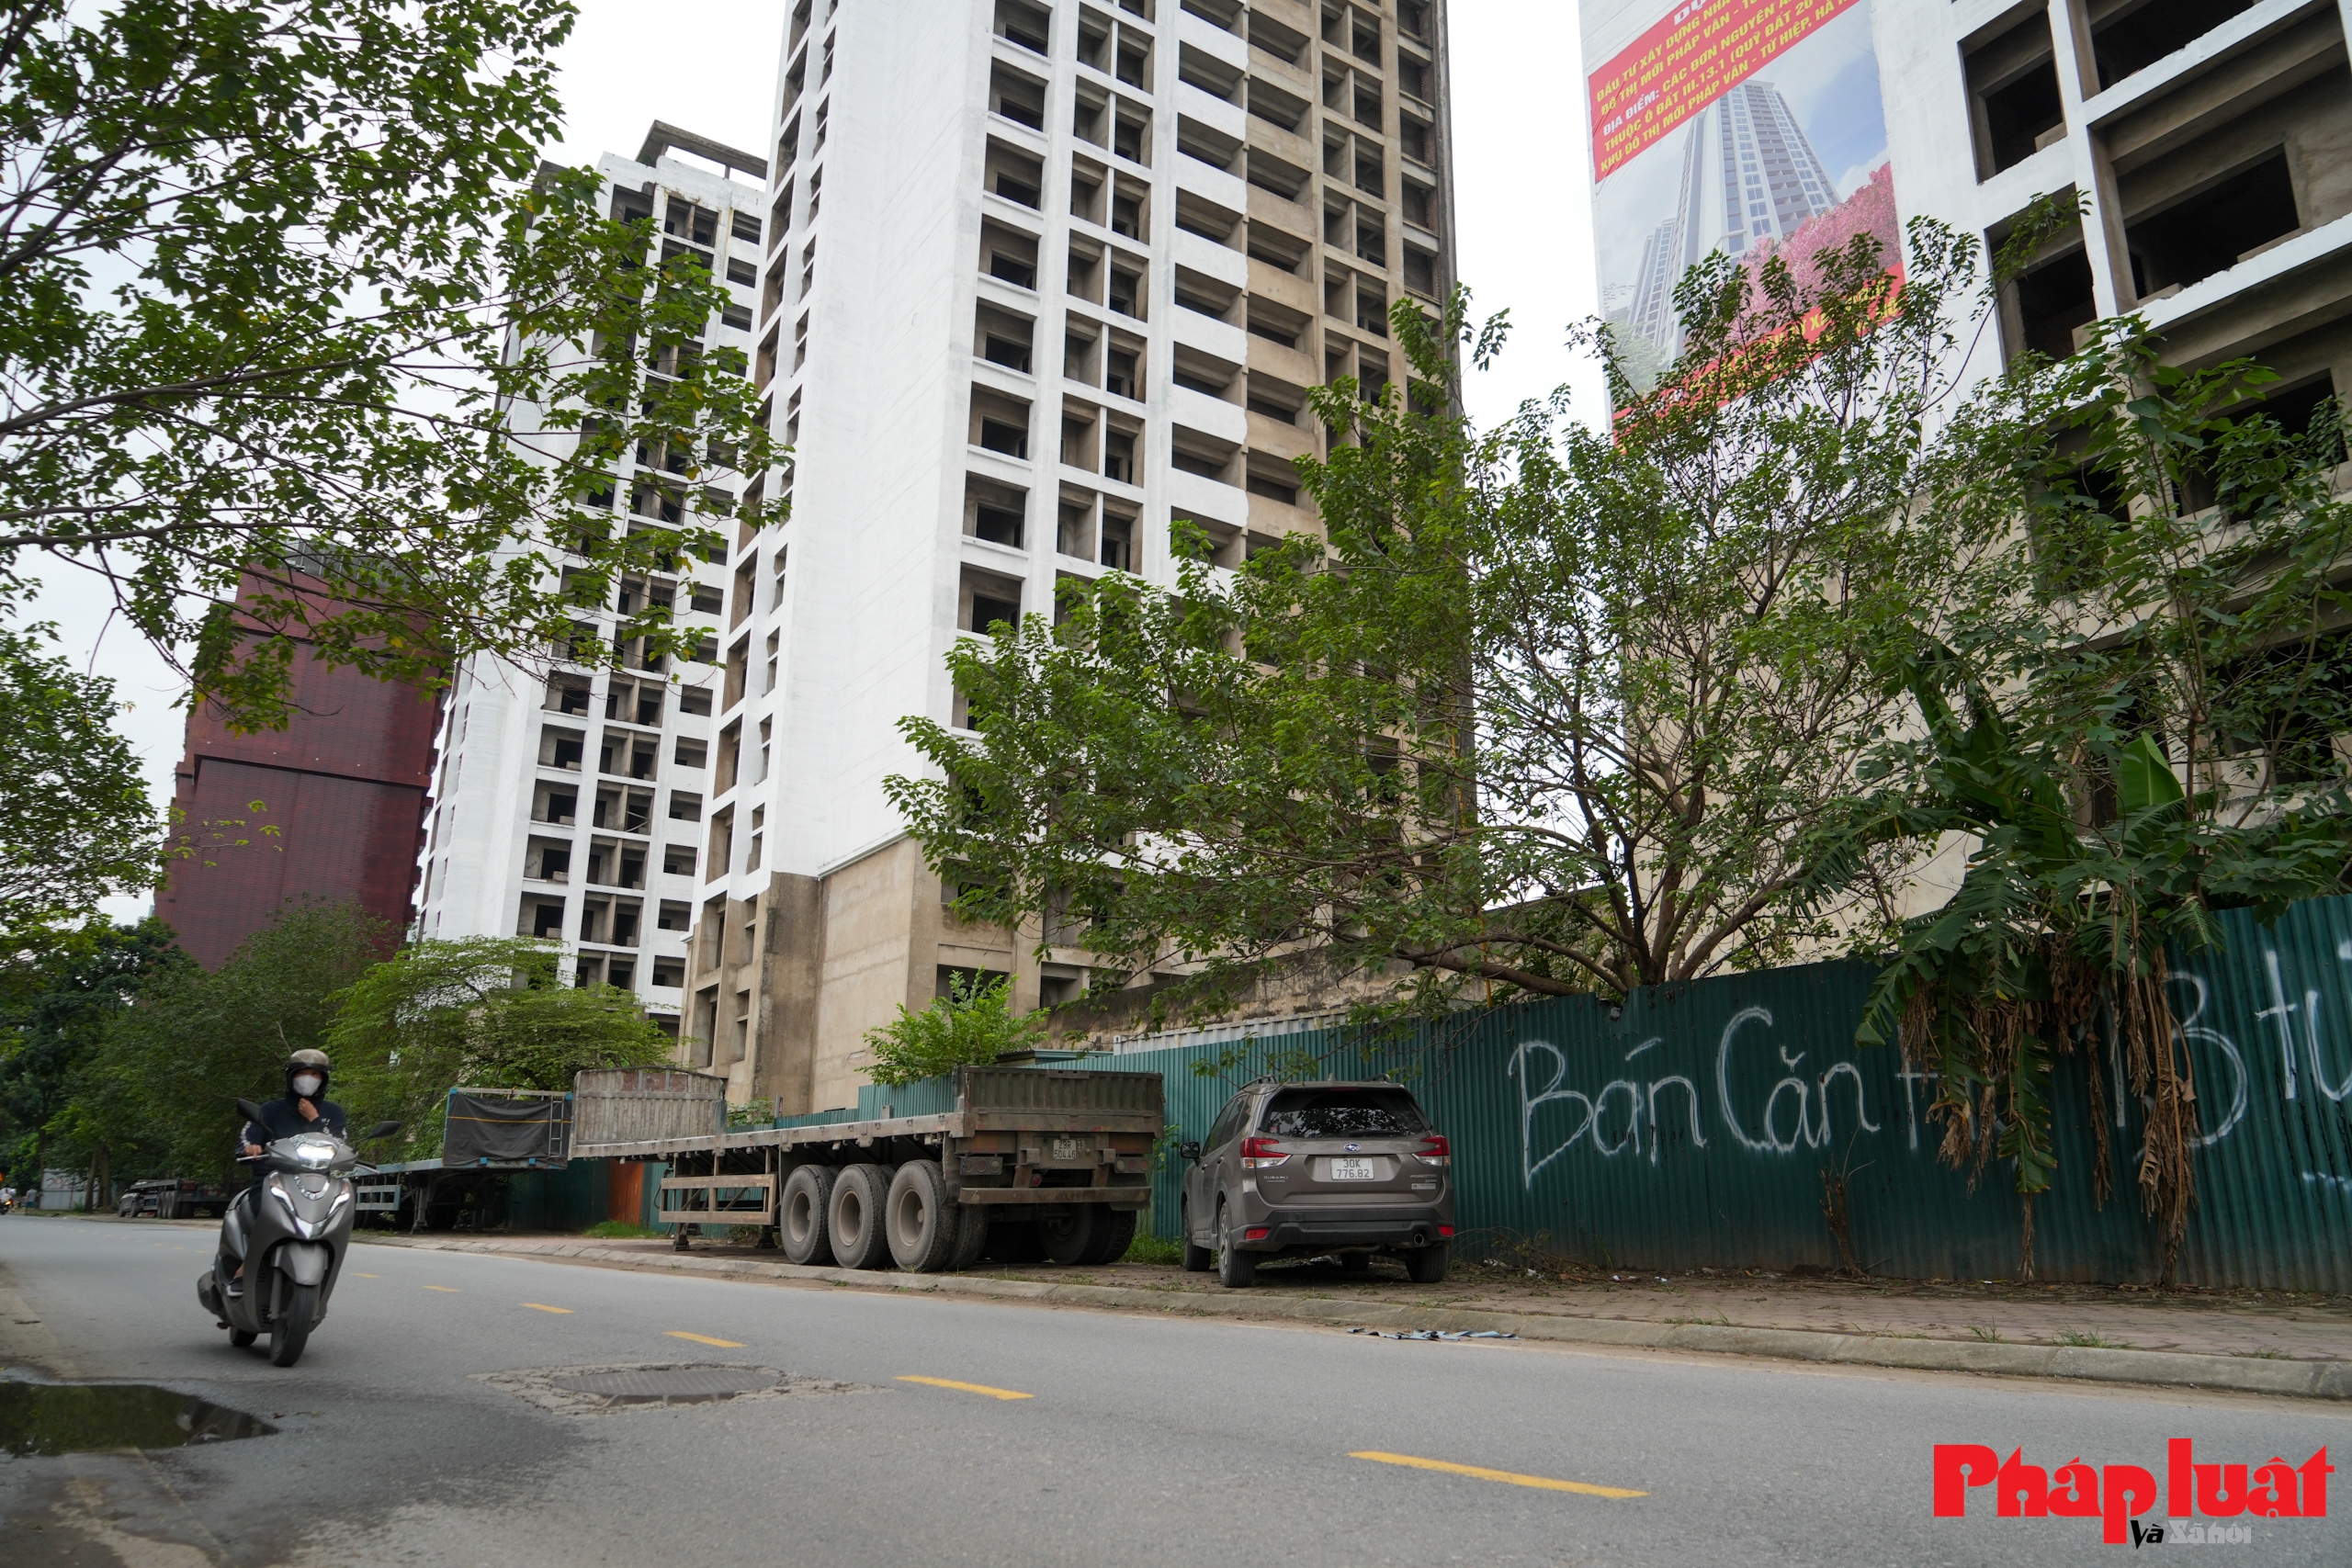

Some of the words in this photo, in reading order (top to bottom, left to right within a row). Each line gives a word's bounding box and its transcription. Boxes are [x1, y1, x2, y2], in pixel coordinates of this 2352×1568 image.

[1597, 77, 1620, 102] ĐẦU
[1622, 62, 1637, 82] TƯ
[1639, 43, 1662, 70] XÂY
[1666, 16, 1701, 50] DỰNG
[1600, 149, 1623, 173] KHU
[1624, 135, 1640, 155] ĐÔ
[1642, 121, 1660, 141] THỊ
[1662, 104, 1686, 129] MỚI
[1688, 80, 1720, 110] PHÁP
[1723, 59, 1748, 85] VÂN
[1760, 37, 1777, 59] TỨ
[1780, 16, 1813, 46] HIỆP,
[1815, 0, 1836, 21] HÀ
[1601, 96, 1617, 116] ĐÔ
[1619, 81, 1638, 102] THỊ
[1640, 61, 1664, 86] MỚI
[1667, 34, 1701, 67] PHÁP
[1702, 11, 1730, 39] VÂN
[1603, 115, 1623, 137] ĐỊA
[1625, 89, 1660, 120] ĐIỂM:
[1662, 67, 1688, 93] CÁC
[1690, 44, 1717, 73] ĐƠN
[1720, 3, 1775, 51] NGUYÊN
[1604, 118, 1642, 152] THUỘC
[1645, 108, 1654, 124] Ô
[1656, 90, 1679, 116] ĐẤT
[1730, 29, 1761, 63] (QUỸ
[1764, 9, 1791, 38] ĐẤT
[1058, 1140, 1071, 1150] 29R
[1508, 1037, 1707, 1190] Bán
[1716, 1006, 1881, 1154] Căn
[1336, 1168, 1370, 1179] 776.82
[1342, 1158, 1362, 1168] 30K
